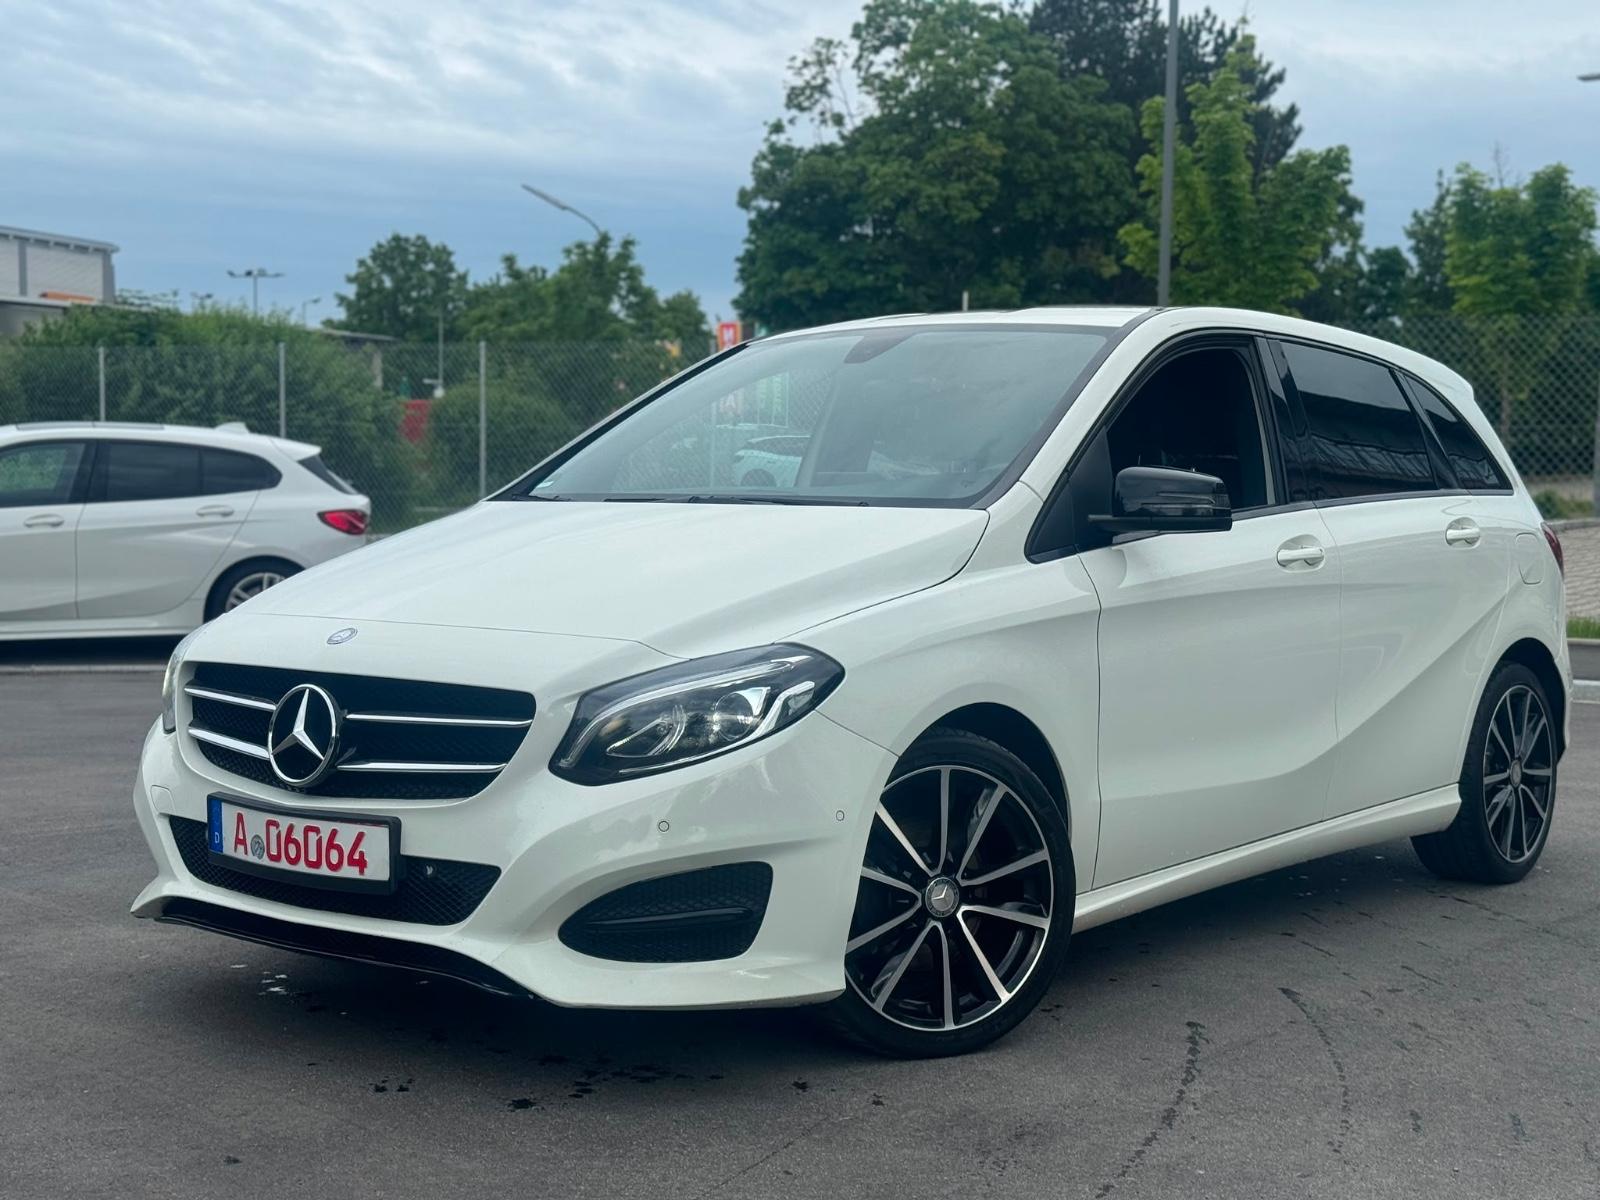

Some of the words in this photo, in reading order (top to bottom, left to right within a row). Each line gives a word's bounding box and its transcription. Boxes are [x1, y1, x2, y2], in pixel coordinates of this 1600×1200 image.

[214, 832, 220, 844] D
[233, 811, 248, 856] A
[265, 818, 368, 876] 06064
